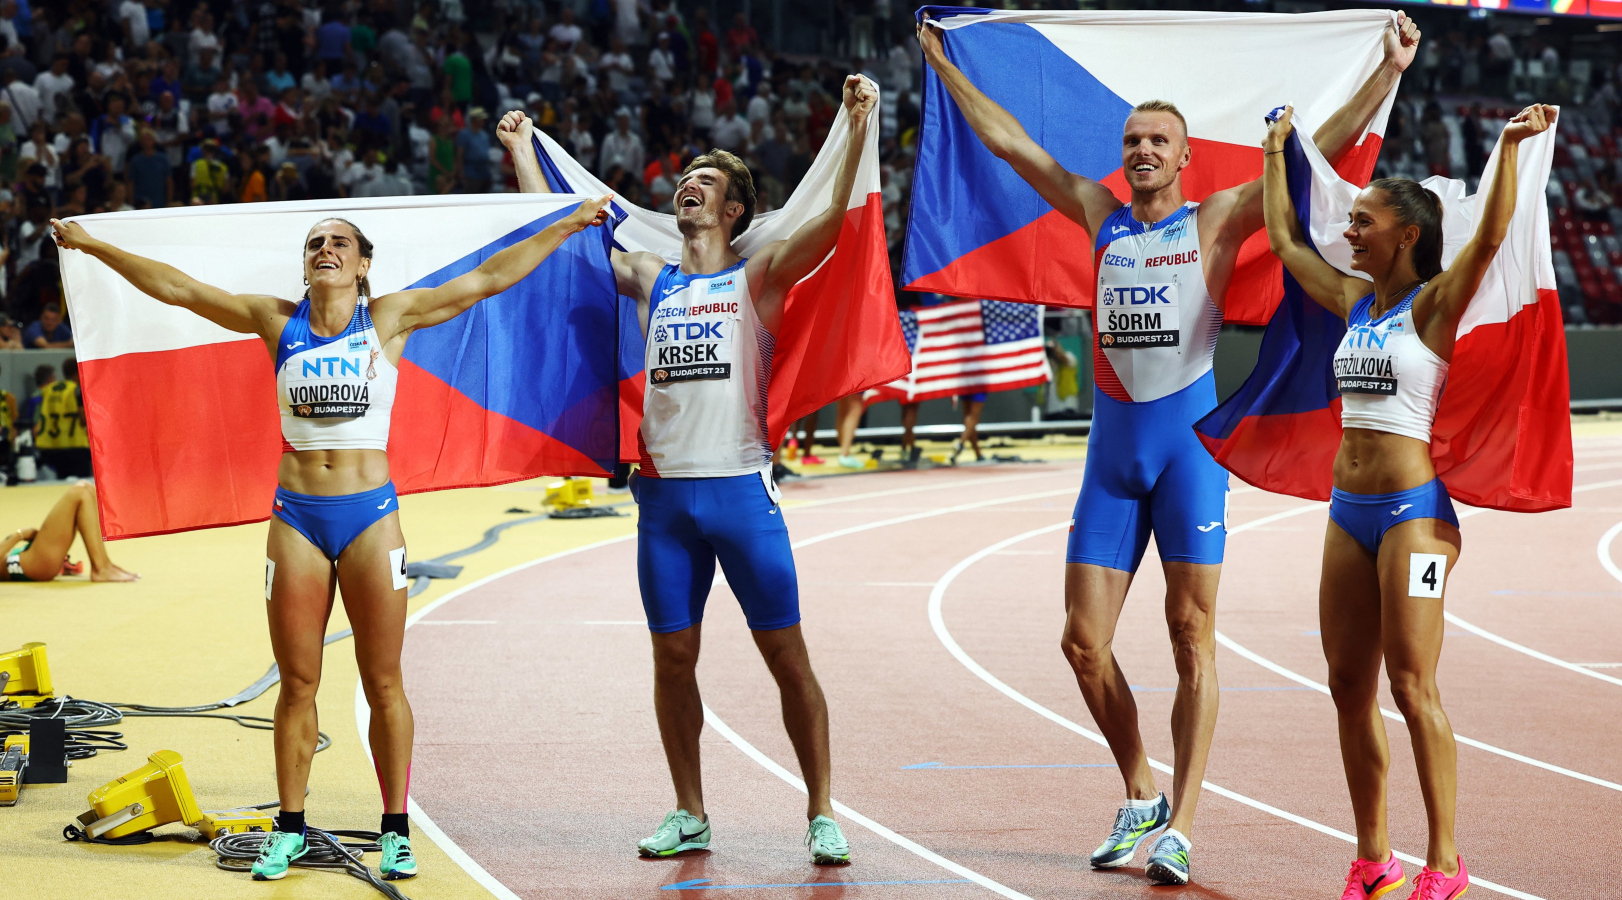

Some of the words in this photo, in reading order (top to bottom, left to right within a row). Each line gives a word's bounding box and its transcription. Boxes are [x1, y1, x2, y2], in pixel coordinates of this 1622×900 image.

[1104, 253, 1136, 269] CZECH
[1145, 249, 1198, 269] REPUBLIC
[1113, 286, 1171, 306] TDK
[689, 302, 738, 317] EPUBLIC
[1108, 309, 1161, 331] ŠORM
[666, 321, 724, 341] TDK
[1116, 335, 1161, 343] BUDAPEST
[1162, 334, 1174, 342] 23
[658, 343, 719, 366] KRSEK
[302, 357, 360, 379] NTN
[670, 367, 714, 377] BUDAPEST
[289, 381, 369, 404] VONDROVÁ
[1340, 380, 1380, 390] BUDAPEST
[1380, 382, 1393, 391] 23
[314, 406, 356, 414] BUDAPEST
[1421, 561, 1437, 591] 4
